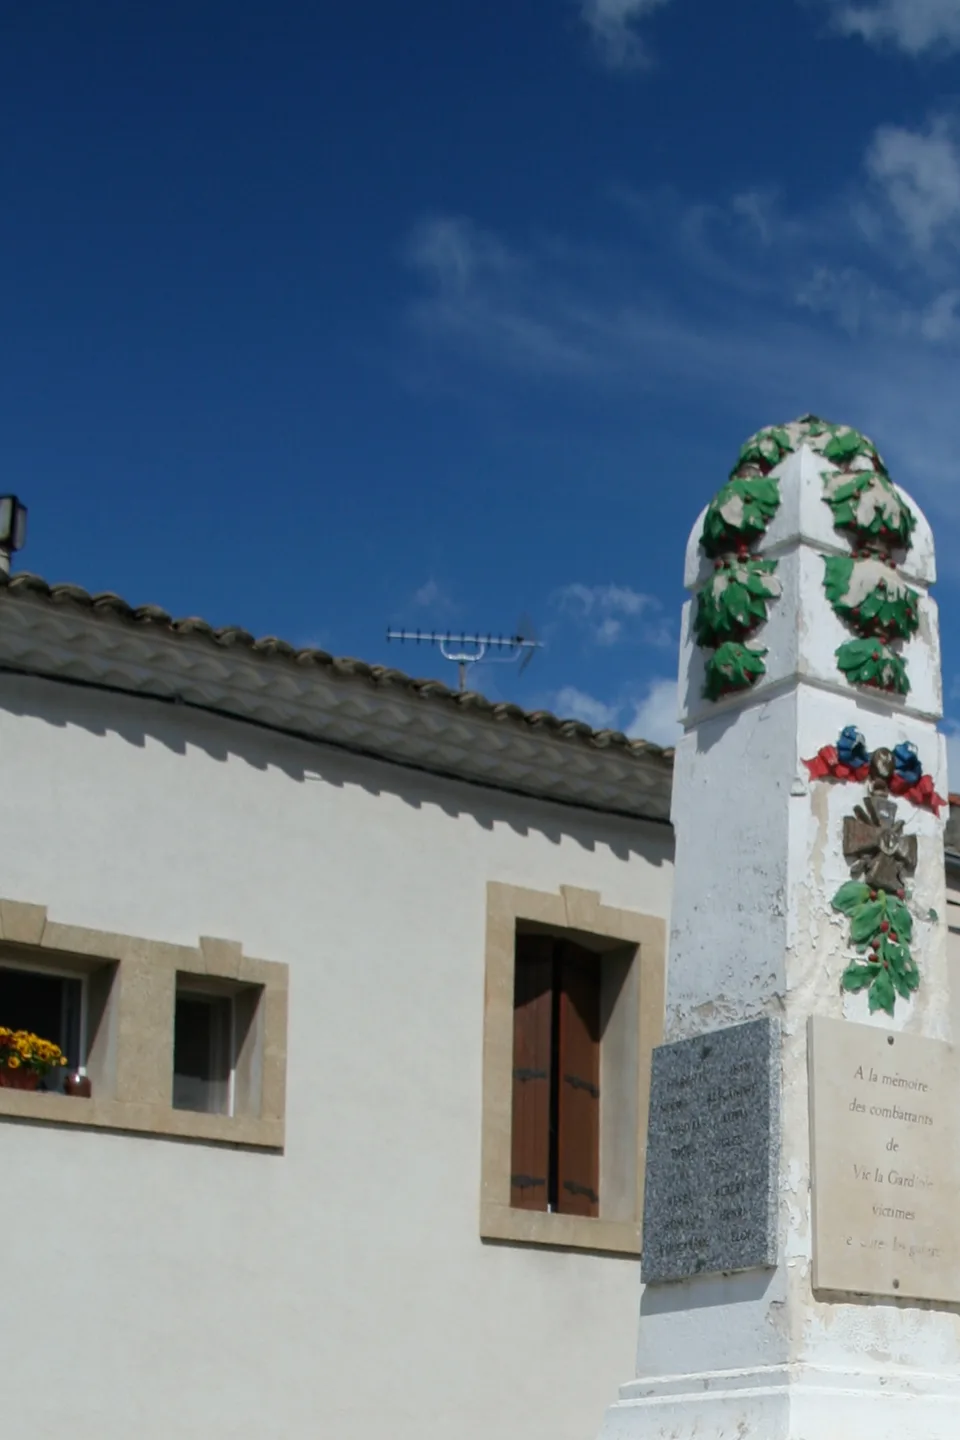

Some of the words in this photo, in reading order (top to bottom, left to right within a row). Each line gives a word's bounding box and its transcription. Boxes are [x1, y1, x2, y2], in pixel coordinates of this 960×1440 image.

[853, 1065, 864, 1080] A
[868, 1067, 878, 1082] la
[882, 1072, 928, 1092] mémoire
[848, 1097, 866, 1113] des
[869, 1104, 934, 1126] combattants
[885, 1137, 900, 1152] de
[853, 1163, 871, 1180] Vic
[874, 1167, 883, 1183] la
[872, 1204, 916, 1221] victimes
